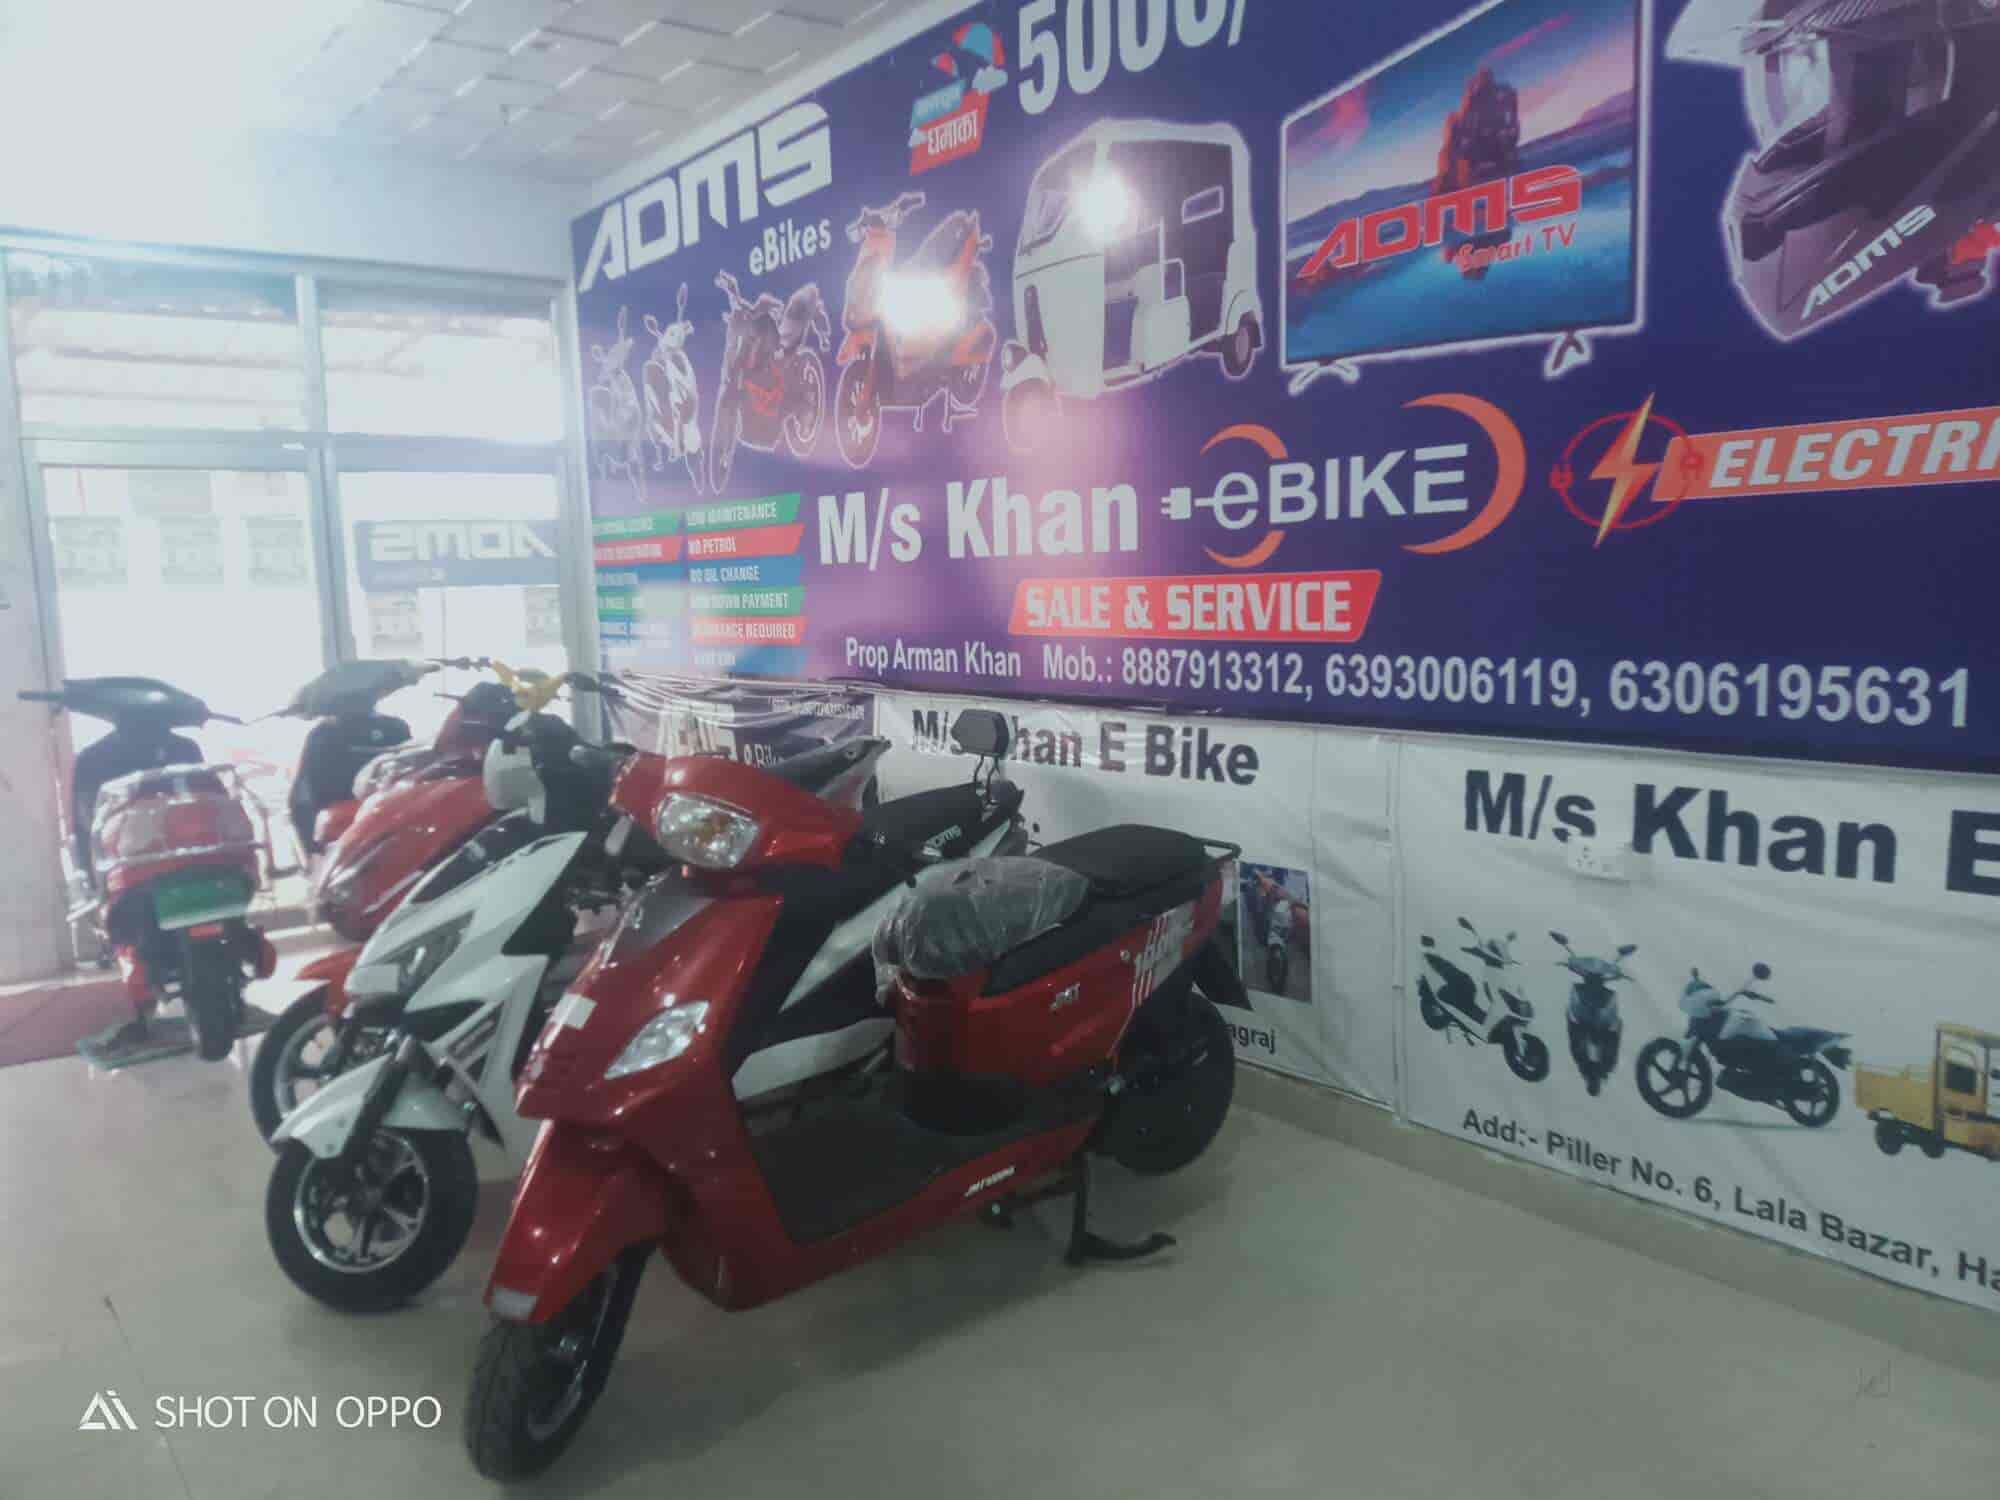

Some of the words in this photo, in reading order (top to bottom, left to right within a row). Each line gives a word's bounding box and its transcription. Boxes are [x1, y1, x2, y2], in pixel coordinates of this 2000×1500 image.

[928, 108, 978, 156] धमाका
[578, 100, 832, 293] ADMS
[1299, 164, 1581, 280] ADMS
[749, 216, 832, 279] eBikes
[1456, 237, 1533, 274] Smart
[1541, 222, 1576, 255] TV
[1801, 204, 1936, 319] ADMS
[818, 488, 924, 571] M/s
[946, 474, 1138, 560] Khan
[1209, 442, 1470, 530] eBIKE
[742, 592, 790, 609] PAYMENT
[1026, 585, 1111, 629] SALE
[1124, 584, 1153, 630] &
[1166, 580, 1353, 633] SERVICE
[846, 637, 889, 675] Prop
[893, 638, 959, 673] Arman
[965, 641, 1021, 677] Khan
[1043, 644, 1113, 684] Mob.:
[1121, 647, 1313, 702] 8887913312,
[1325, 653, 1591, 717] 6393006119,
[1609, 660, 1969, 728] 6306195631
[1011, 715, 1083, 767] han
[1099, 721, 1128, 772] E
[1145, 724, 1260, 786] Bike
[1464, 769, 1596, 844] M/s
[1632, 783, 1897, 884] Khan
[1231, 1025, 1276, 1055] graj
[1546, 1132, 1622, 1178] Piller
[1631, 1156, 1683, 1196] No.
[1694, 1176, 1721, 1211] 6,
[1733, 1187, 1808, 1234] Lala
[1820, 1211, 1939, 1277] Bazar,
